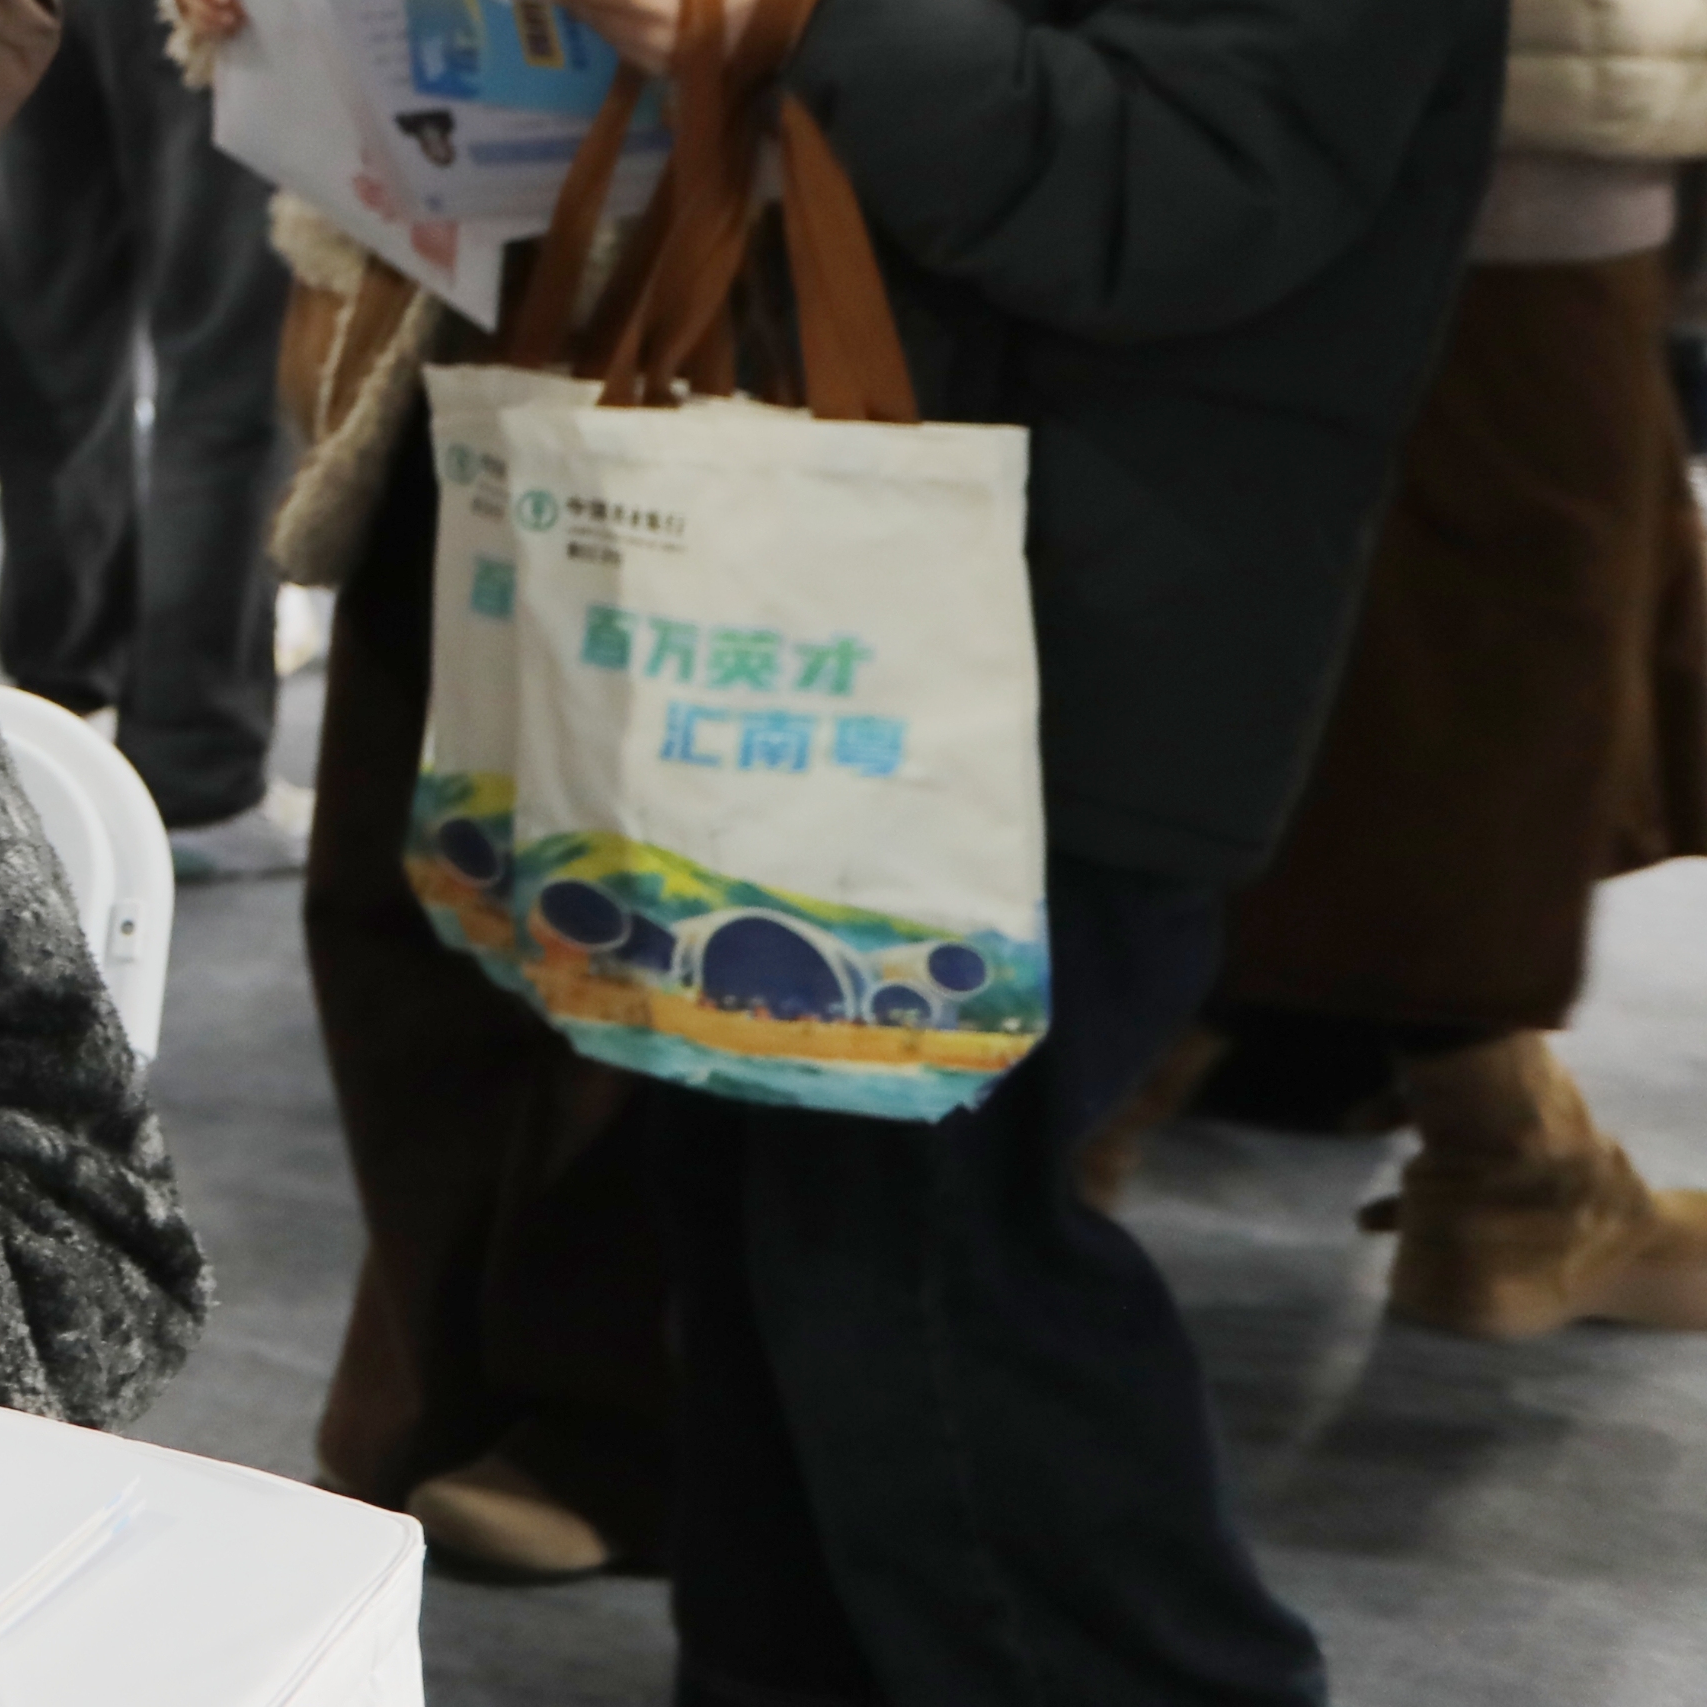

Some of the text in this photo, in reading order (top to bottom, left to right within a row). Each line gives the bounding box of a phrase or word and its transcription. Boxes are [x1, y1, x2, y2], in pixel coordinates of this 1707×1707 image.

[580, 604, 873, 696] 百万英才
[661, 701, 910, 779] 汇南粤
